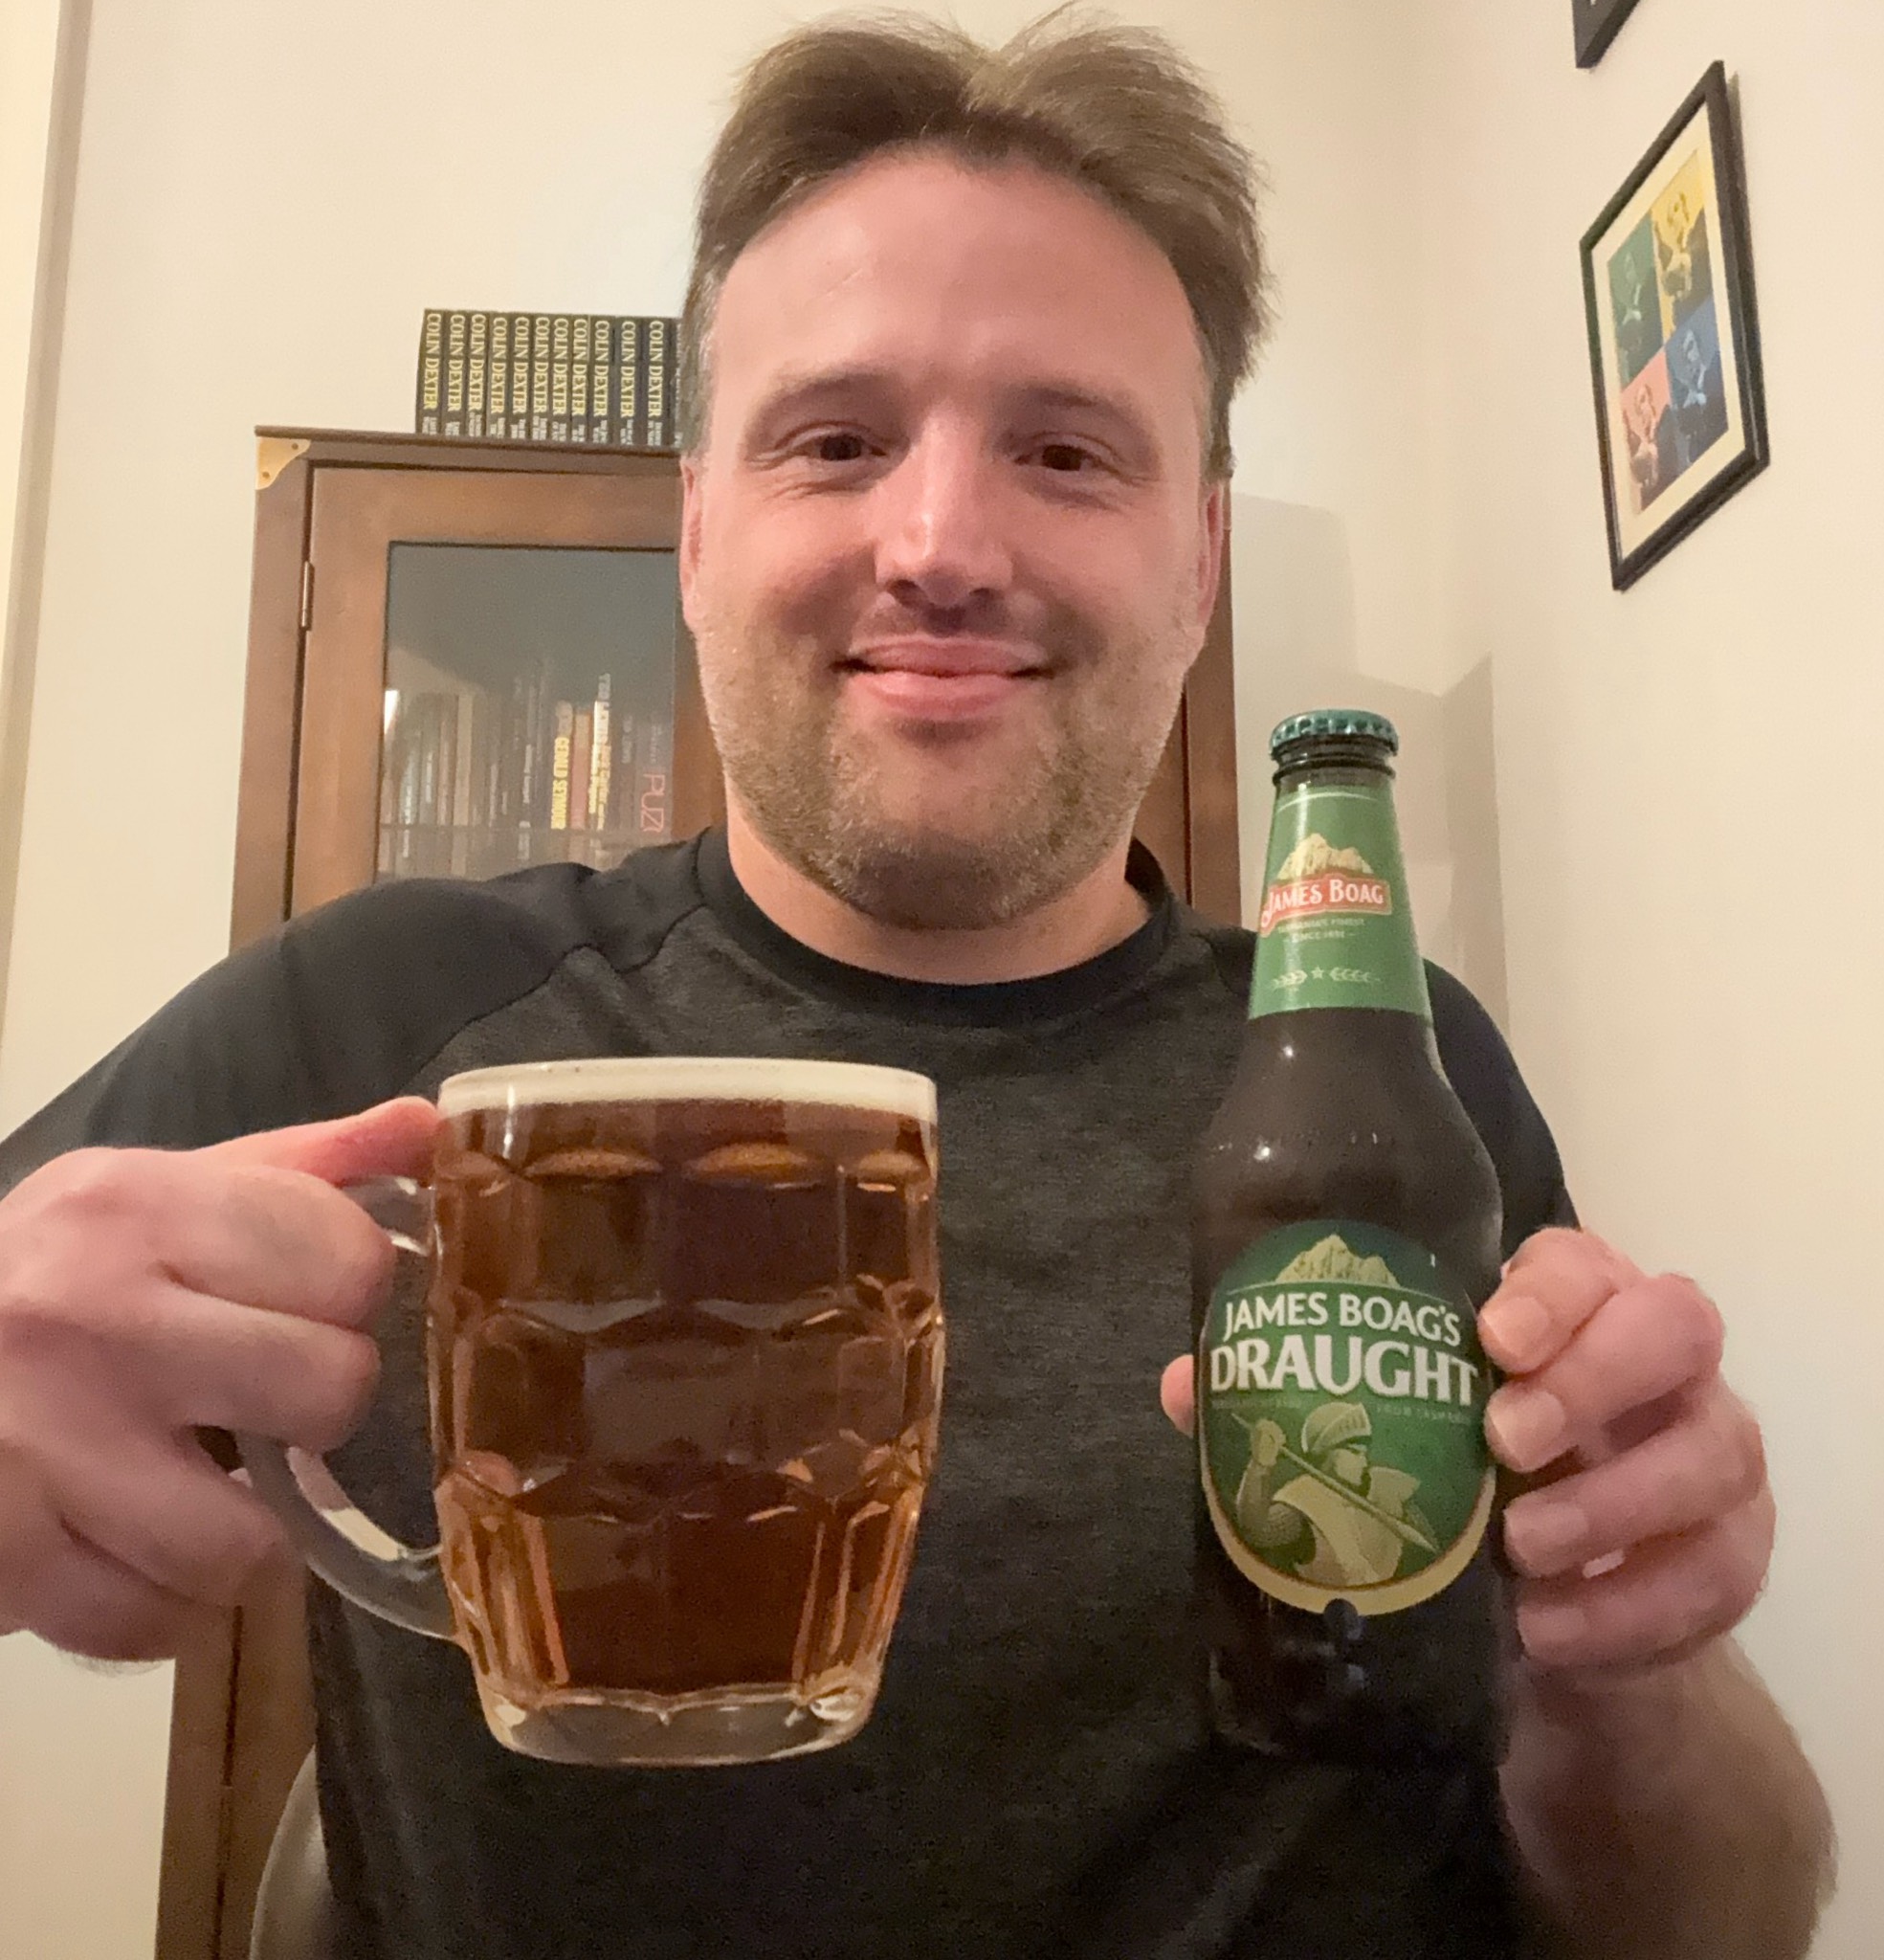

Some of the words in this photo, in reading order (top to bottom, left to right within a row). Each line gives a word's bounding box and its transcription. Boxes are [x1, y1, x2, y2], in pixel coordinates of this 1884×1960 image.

[427, 313, 441, 354] COLIN
[450, 314, 465, 356] COLIN
[471, 314, 486, 357] COLIN
[492, 317, 507, 360] COLIN
[515, 317, 529, 360] COLIN
[534, 317, 549, 359] COLIN
[553, 318, 568, 360] COLIN
[573, 318, 587, 361] COLIN
[595, 320, 610, 362] COLIN
[621, 321, 635, 363] COLIN
[649, 320, 664, 363] COLIN
[423, 357, 440, 410] DEXTER
[448, 359, 462, 412] DEXTER
[468, 358, 484, 414] DEXTER
[490, 362, 505, 413] DEXTER
[513, 362, 528, 413] DEXTER
[533, 360, 548, 413] DEXTER
[552, 363, 567, 415] DEXTER
[572, 364, 587, 416] DEXTER
[593, 365, 609, 417] DEXTER
[620, 366, 634, 417] DEXTER
[648, 366, 663, 418] DEXTER
[551, 779, 568, 830] SEYMOUR
[1261, 884, 1322, 928] JAMES
[1329, 879, 1384, 904] BOAG
[1222, 1292, 1328, 1343] JAMES
[1339, 1292, 1461, 1348] BOAG'S
[1210, 1334, 1478, 1407] DRAUGHT
